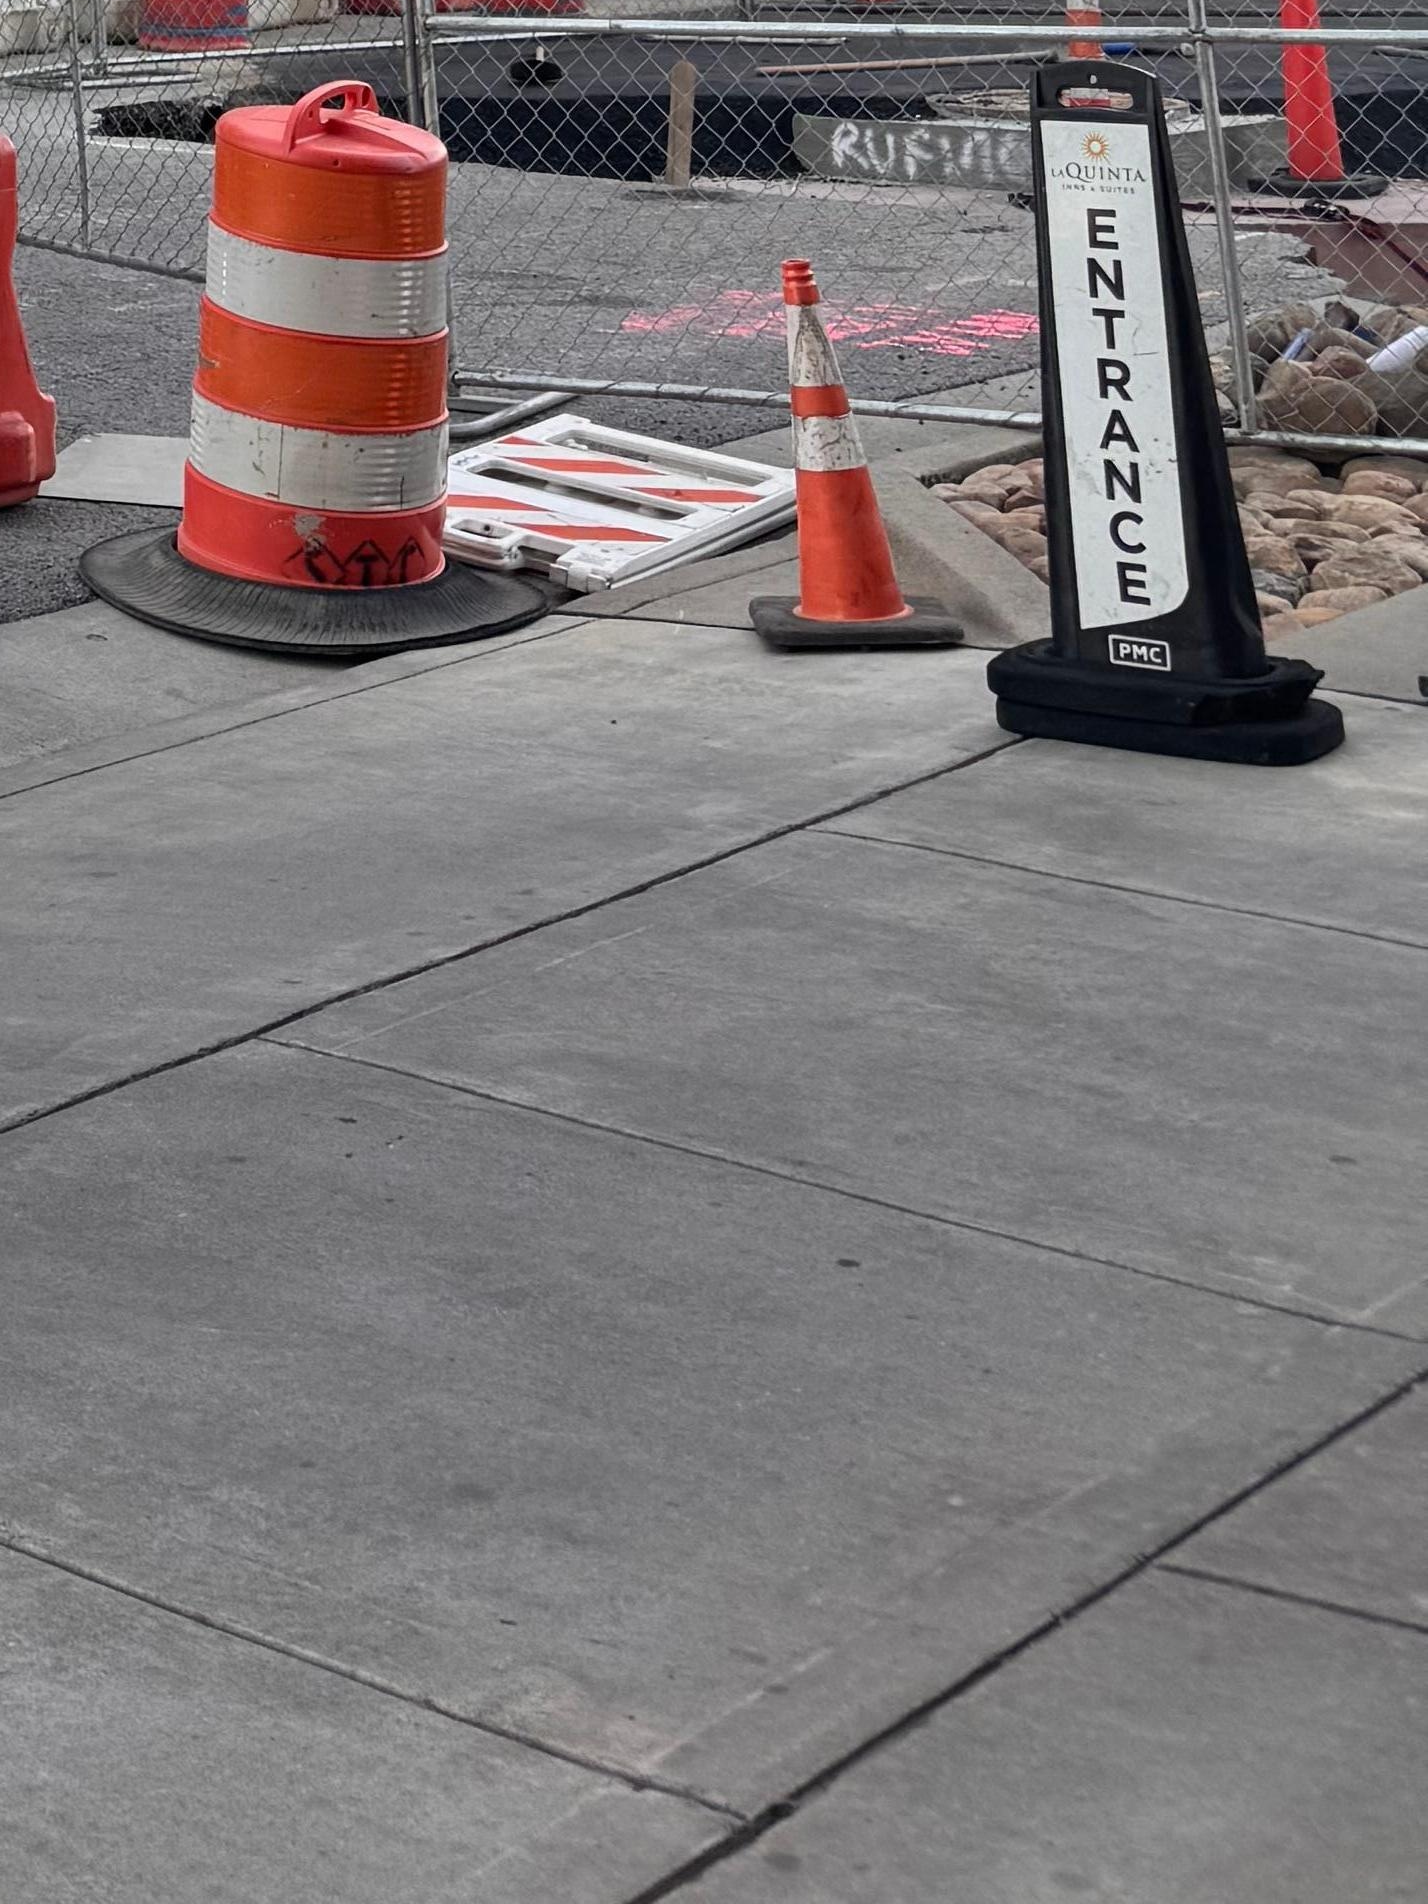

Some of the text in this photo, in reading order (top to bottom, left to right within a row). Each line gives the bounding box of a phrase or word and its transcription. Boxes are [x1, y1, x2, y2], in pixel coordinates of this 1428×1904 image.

[1065, 161, 1147, 183] QUINTA
[1085, 208, 1151, 606] ENTRANCE
[1118, 641, 1163, 665] PMC
